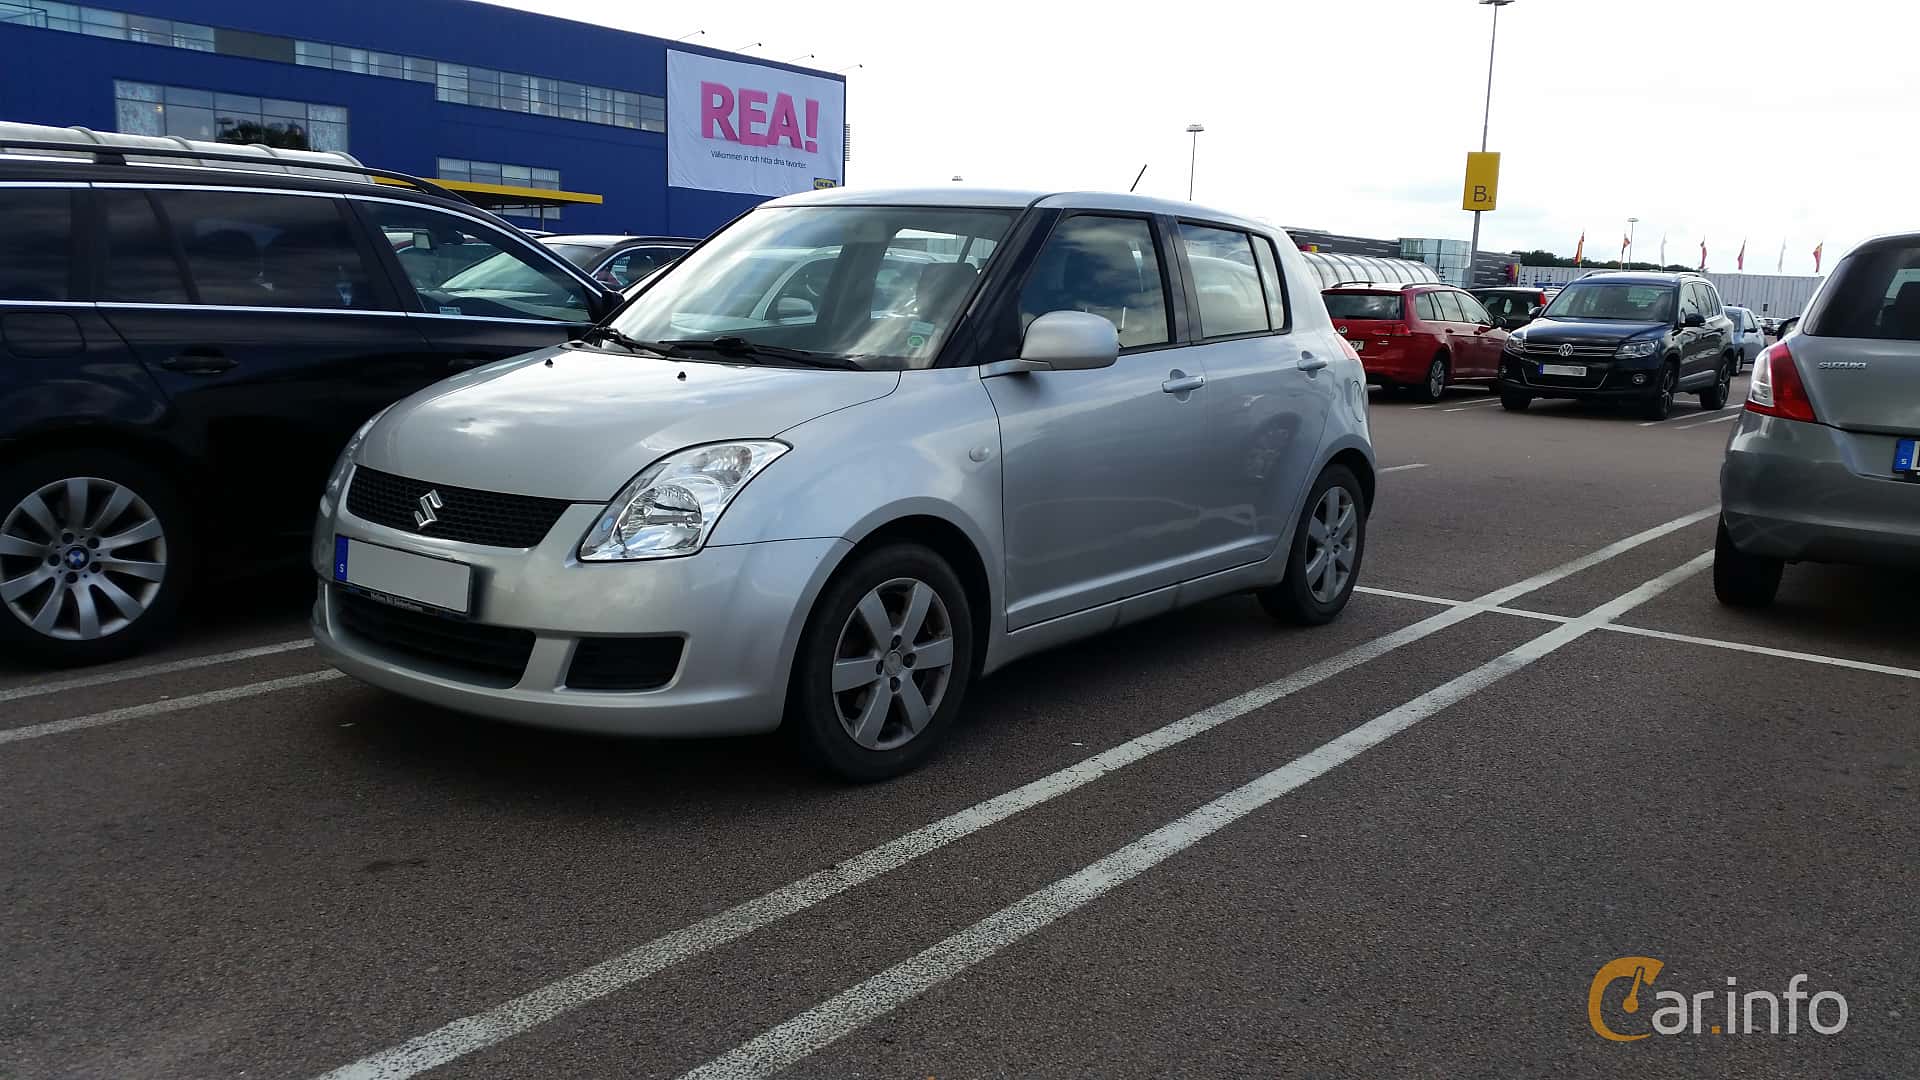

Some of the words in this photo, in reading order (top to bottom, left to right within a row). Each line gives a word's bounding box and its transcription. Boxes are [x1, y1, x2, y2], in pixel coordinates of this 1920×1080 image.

[701, 80, 819, 154] REA!
[761, 156, 772, 164] hitta
[774, 158, 784, 166] dina
[816, 180, 834, 188] IKEA
[1818, 361, 1867, 370] SUZUKI
[339, 563, 345, 573] S
